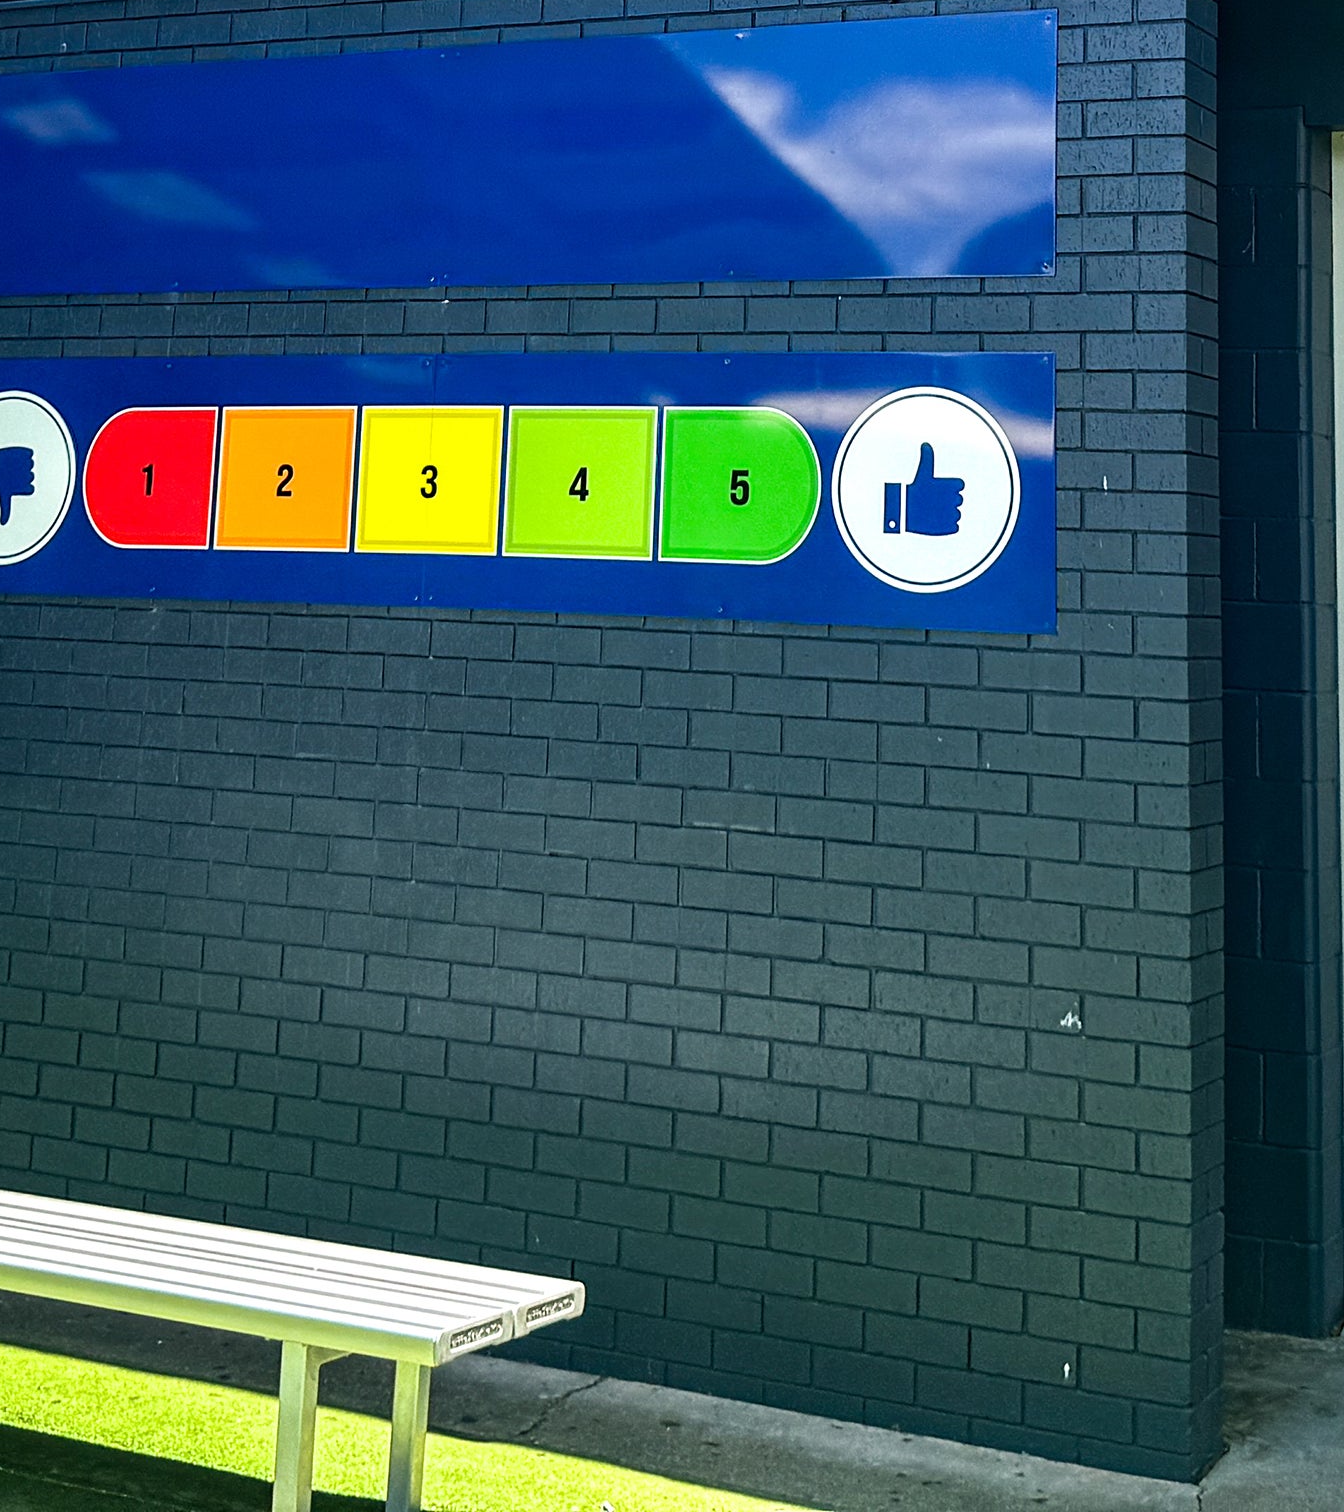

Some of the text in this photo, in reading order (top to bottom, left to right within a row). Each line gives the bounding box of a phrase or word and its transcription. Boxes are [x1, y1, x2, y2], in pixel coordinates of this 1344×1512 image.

[141, 463, 750, 506] 1 2 3 4 5
